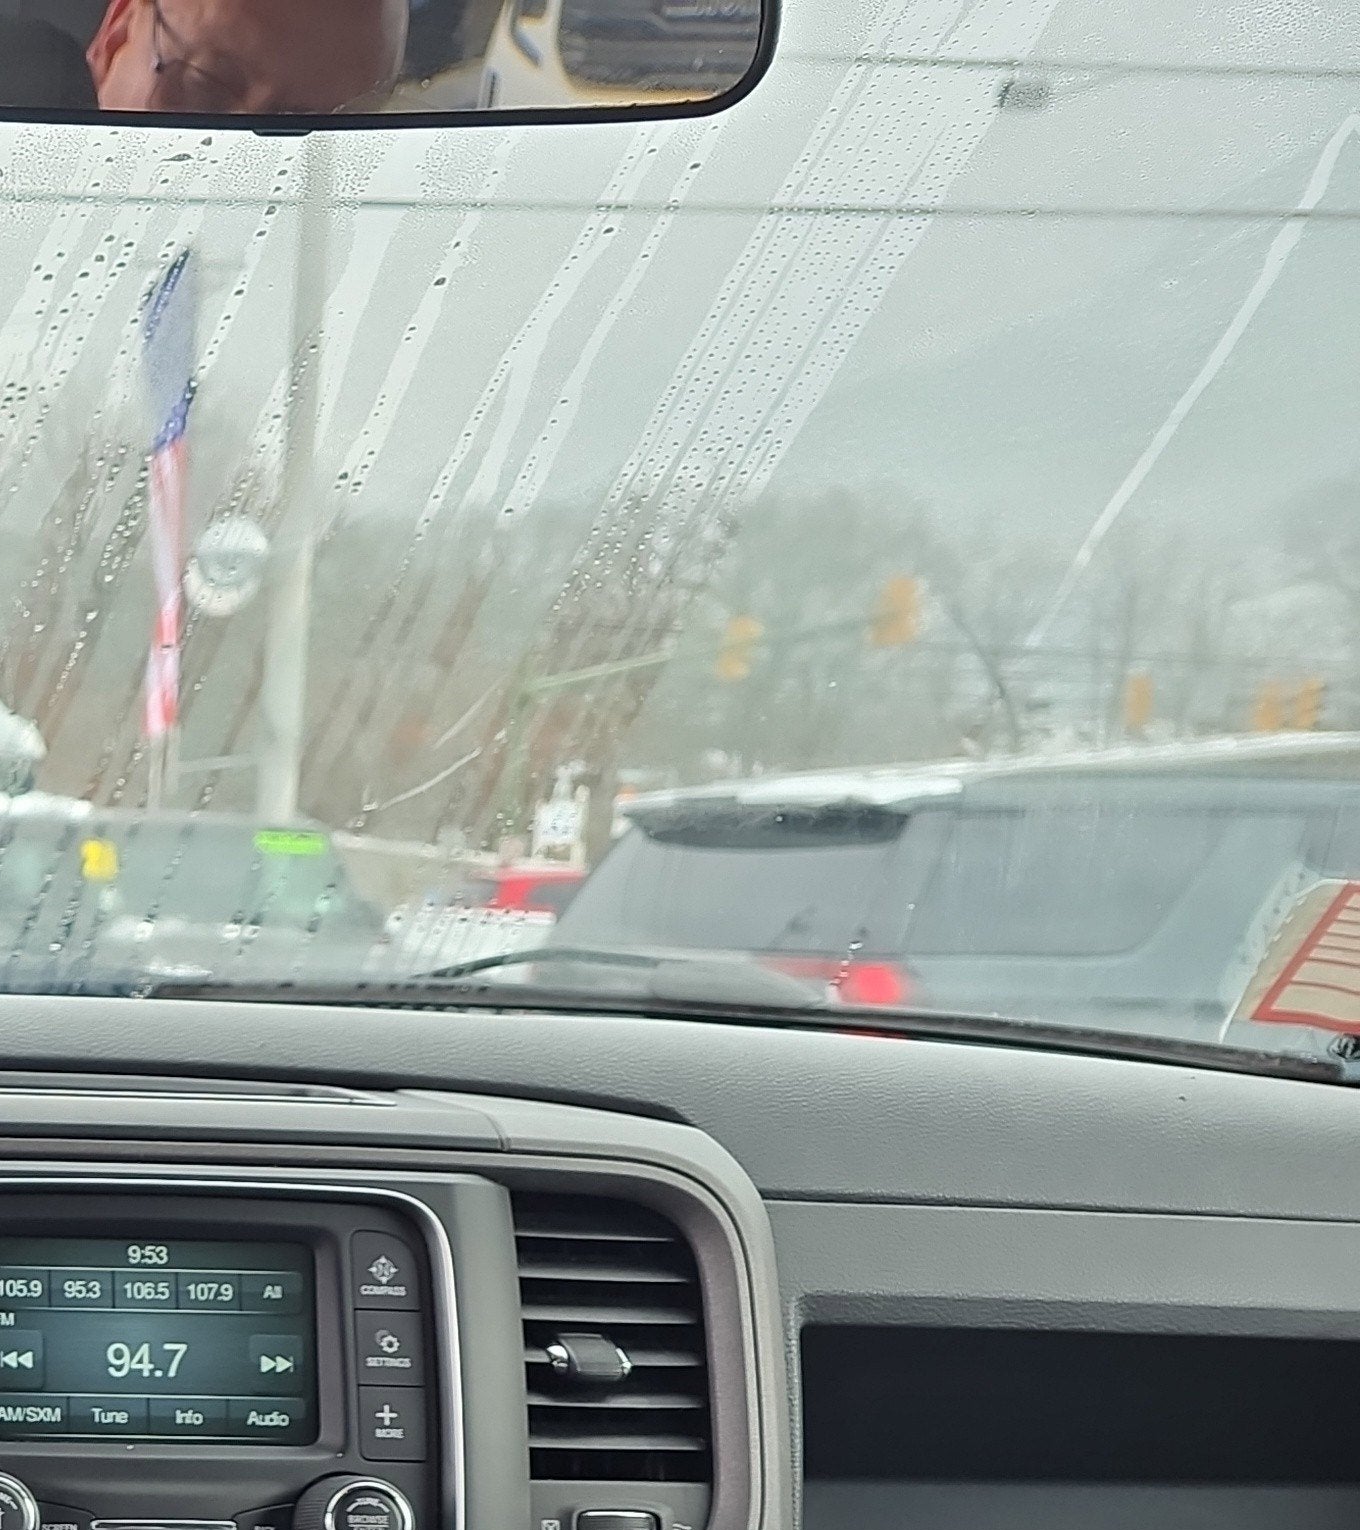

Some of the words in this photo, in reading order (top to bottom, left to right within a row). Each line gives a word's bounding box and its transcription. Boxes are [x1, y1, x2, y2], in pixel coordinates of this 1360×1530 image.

[127, 1245, 169, 1265] 9:53
[63, 1280, 102, 1299] 95.3
[123, 1282, 170, 1300] 106.5
[186, 1283, 234, 1302] 107.9
[262, 1285, 283, 1300] All
[106, 1342, 188, 1378] 94.7
[91, 1408, 128, 1424] Tune
[175, 1409, 204, 1425] Info
[246, 1410, 290, 1427] Audio
